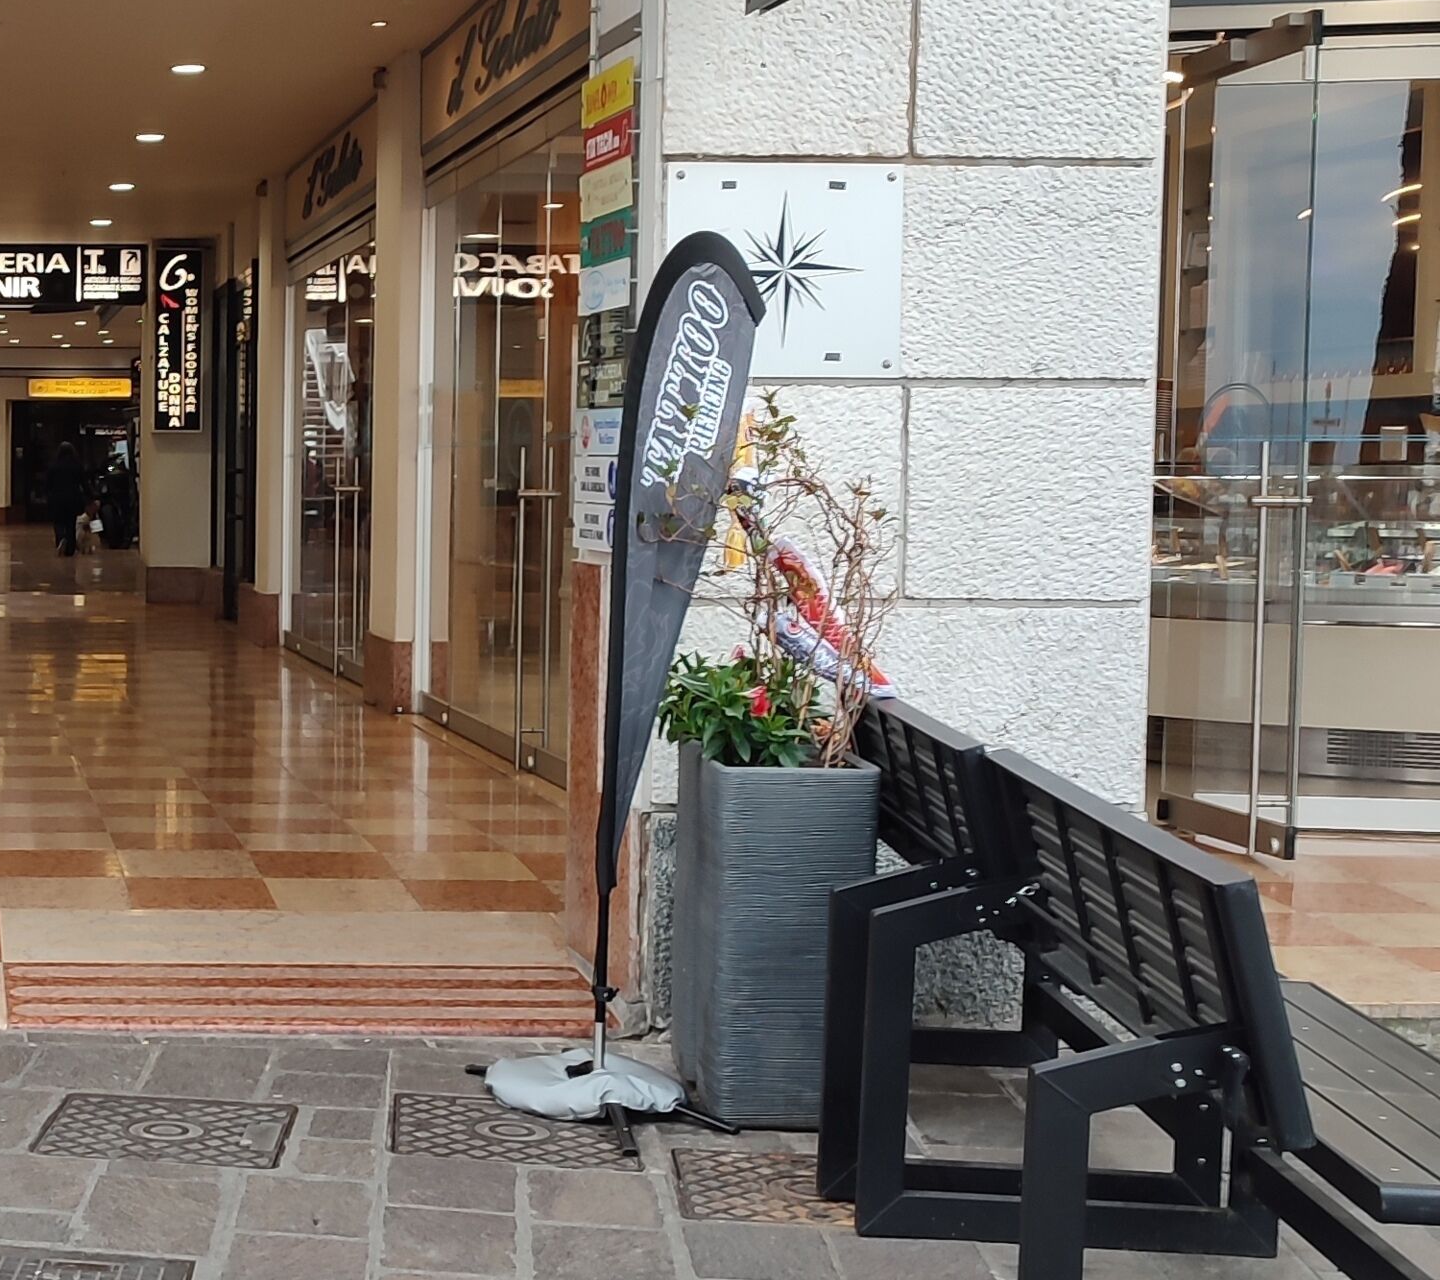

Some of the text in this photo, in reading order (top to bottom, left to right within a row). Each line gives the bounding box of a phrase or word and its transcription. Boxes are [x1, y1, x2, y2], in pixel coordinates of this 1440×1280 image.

[157, 313, 170, 412] CALZATURE
[169, 372, 181, 427] DONNA
[184, 343, 198, 413] FOOTWEAR
[689, 358, 731, 456] PIERCING
